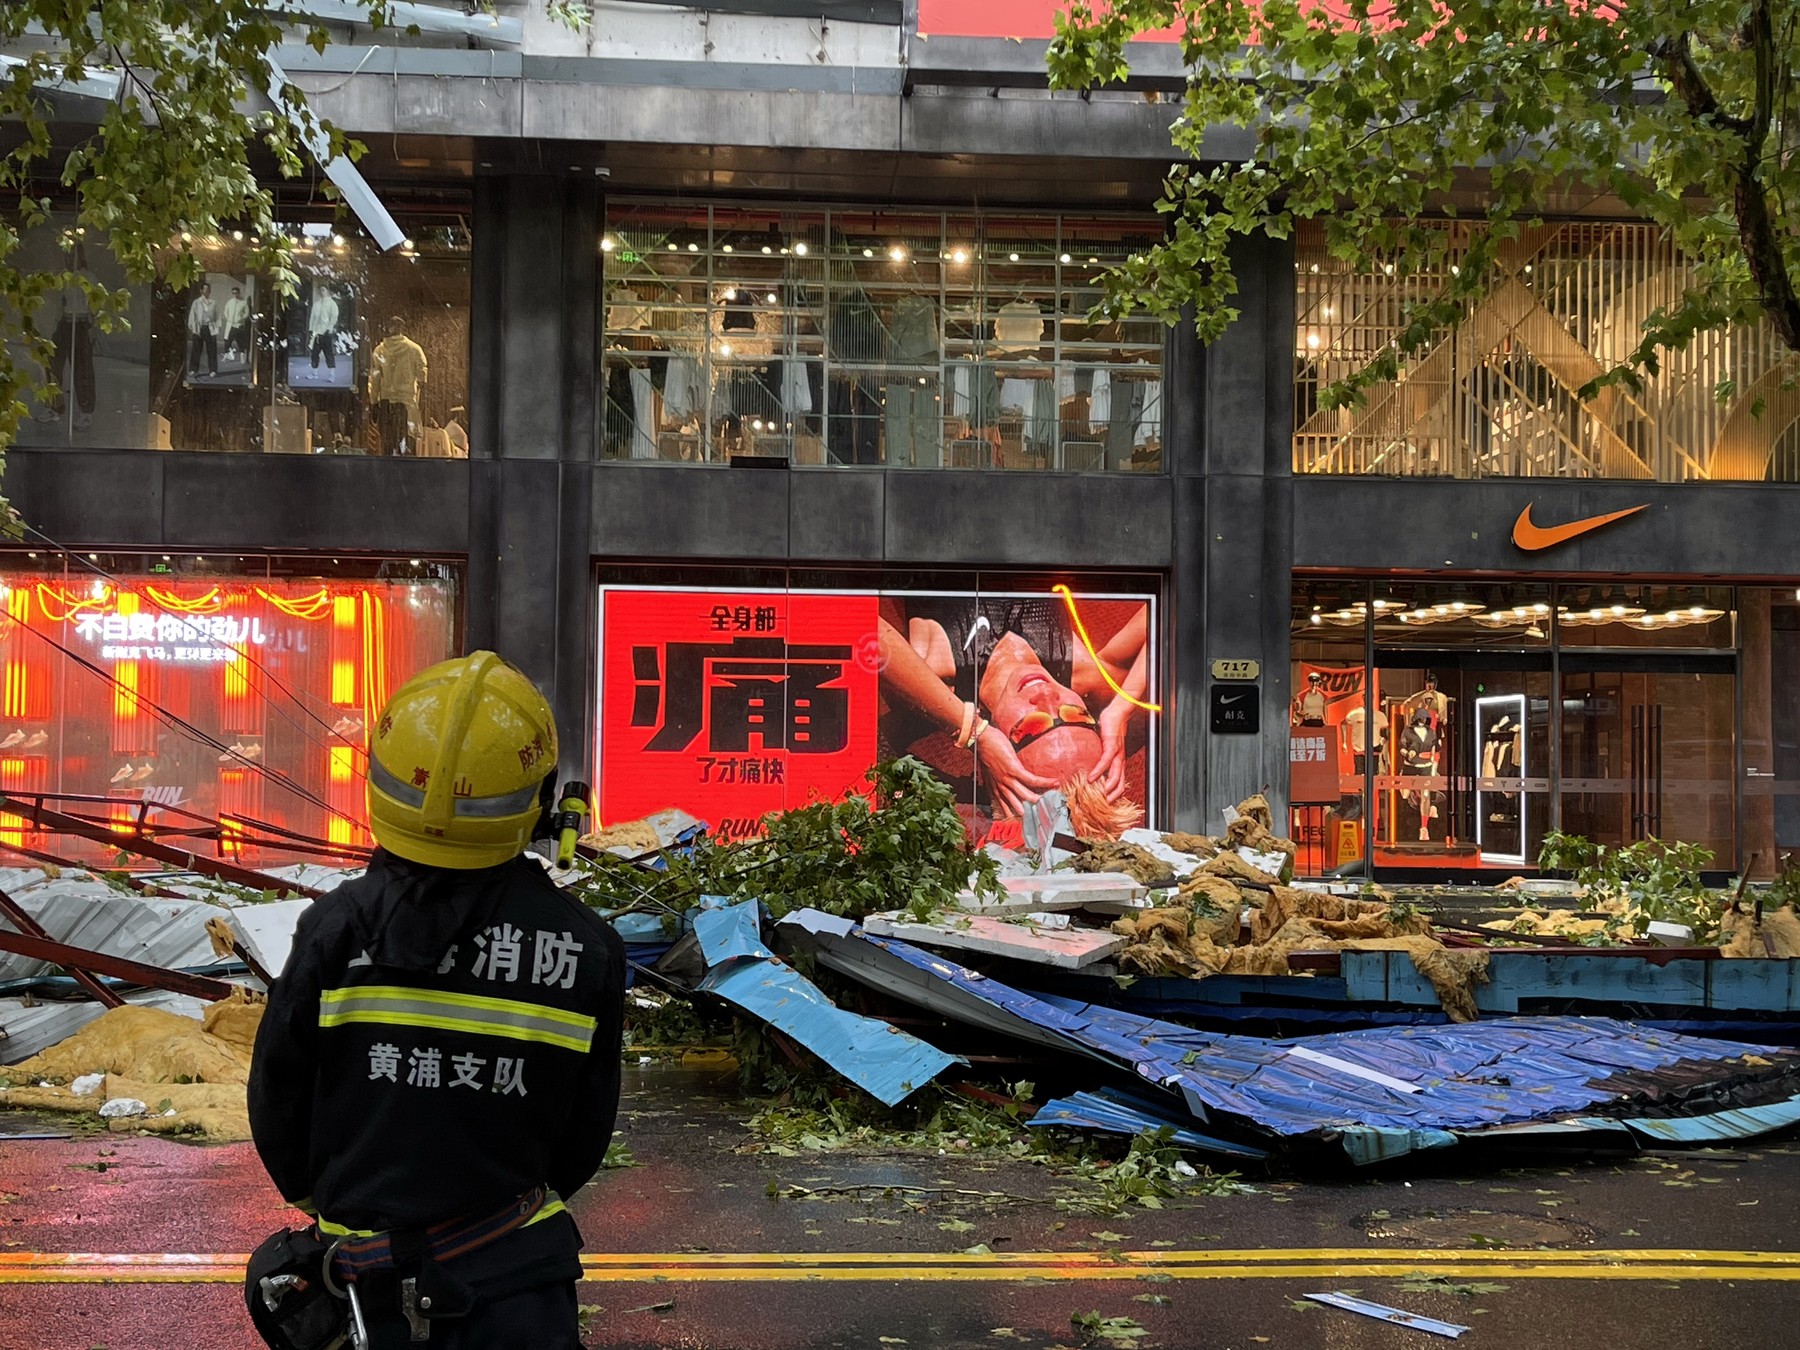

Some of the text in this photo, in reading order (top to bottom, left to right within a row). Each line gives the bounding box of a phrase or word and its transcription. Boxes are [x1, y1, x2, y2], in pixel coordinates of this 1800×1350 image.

[75, 613, 266, 644] 不白费你的劲儿
[710, 605, 776, 631] 全身都
[1221, 662, 1249, 671] 717
[1319, 672, 1363, 692] RUN
[632, 636, 853, 753] 痛
[1225, 710, 1246, 720] 耐克
[696, 757, 784, 784] 了才痛快
[142, 786, 183, 806] RUN
[717, 818, 761, 838] RUN
[368, 1043, 528, 1097] 黄浦支队
